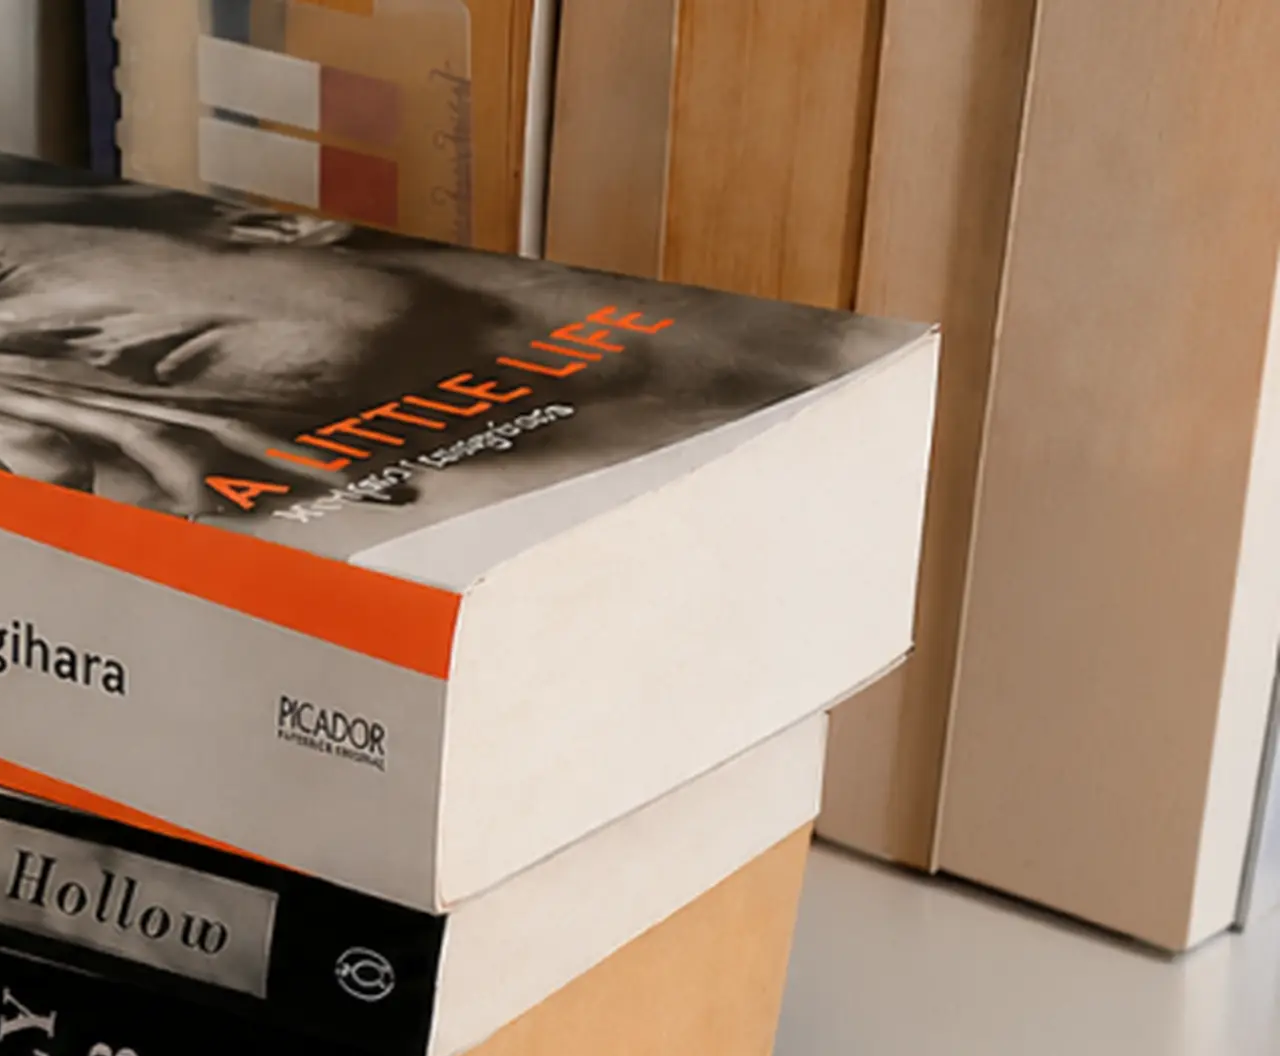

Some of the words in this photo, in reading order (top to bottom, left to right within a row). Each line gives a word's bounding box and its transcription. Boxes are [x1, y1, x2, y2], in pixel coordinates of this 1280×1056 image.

[205, 472, 290, 510] A
[266, 373, 532, 472] LITTLE
[496, 305, 675, 378] LIFE
[278, 695, 385, 755] PICADOR
[6, 848, 228, 956] Hollow
